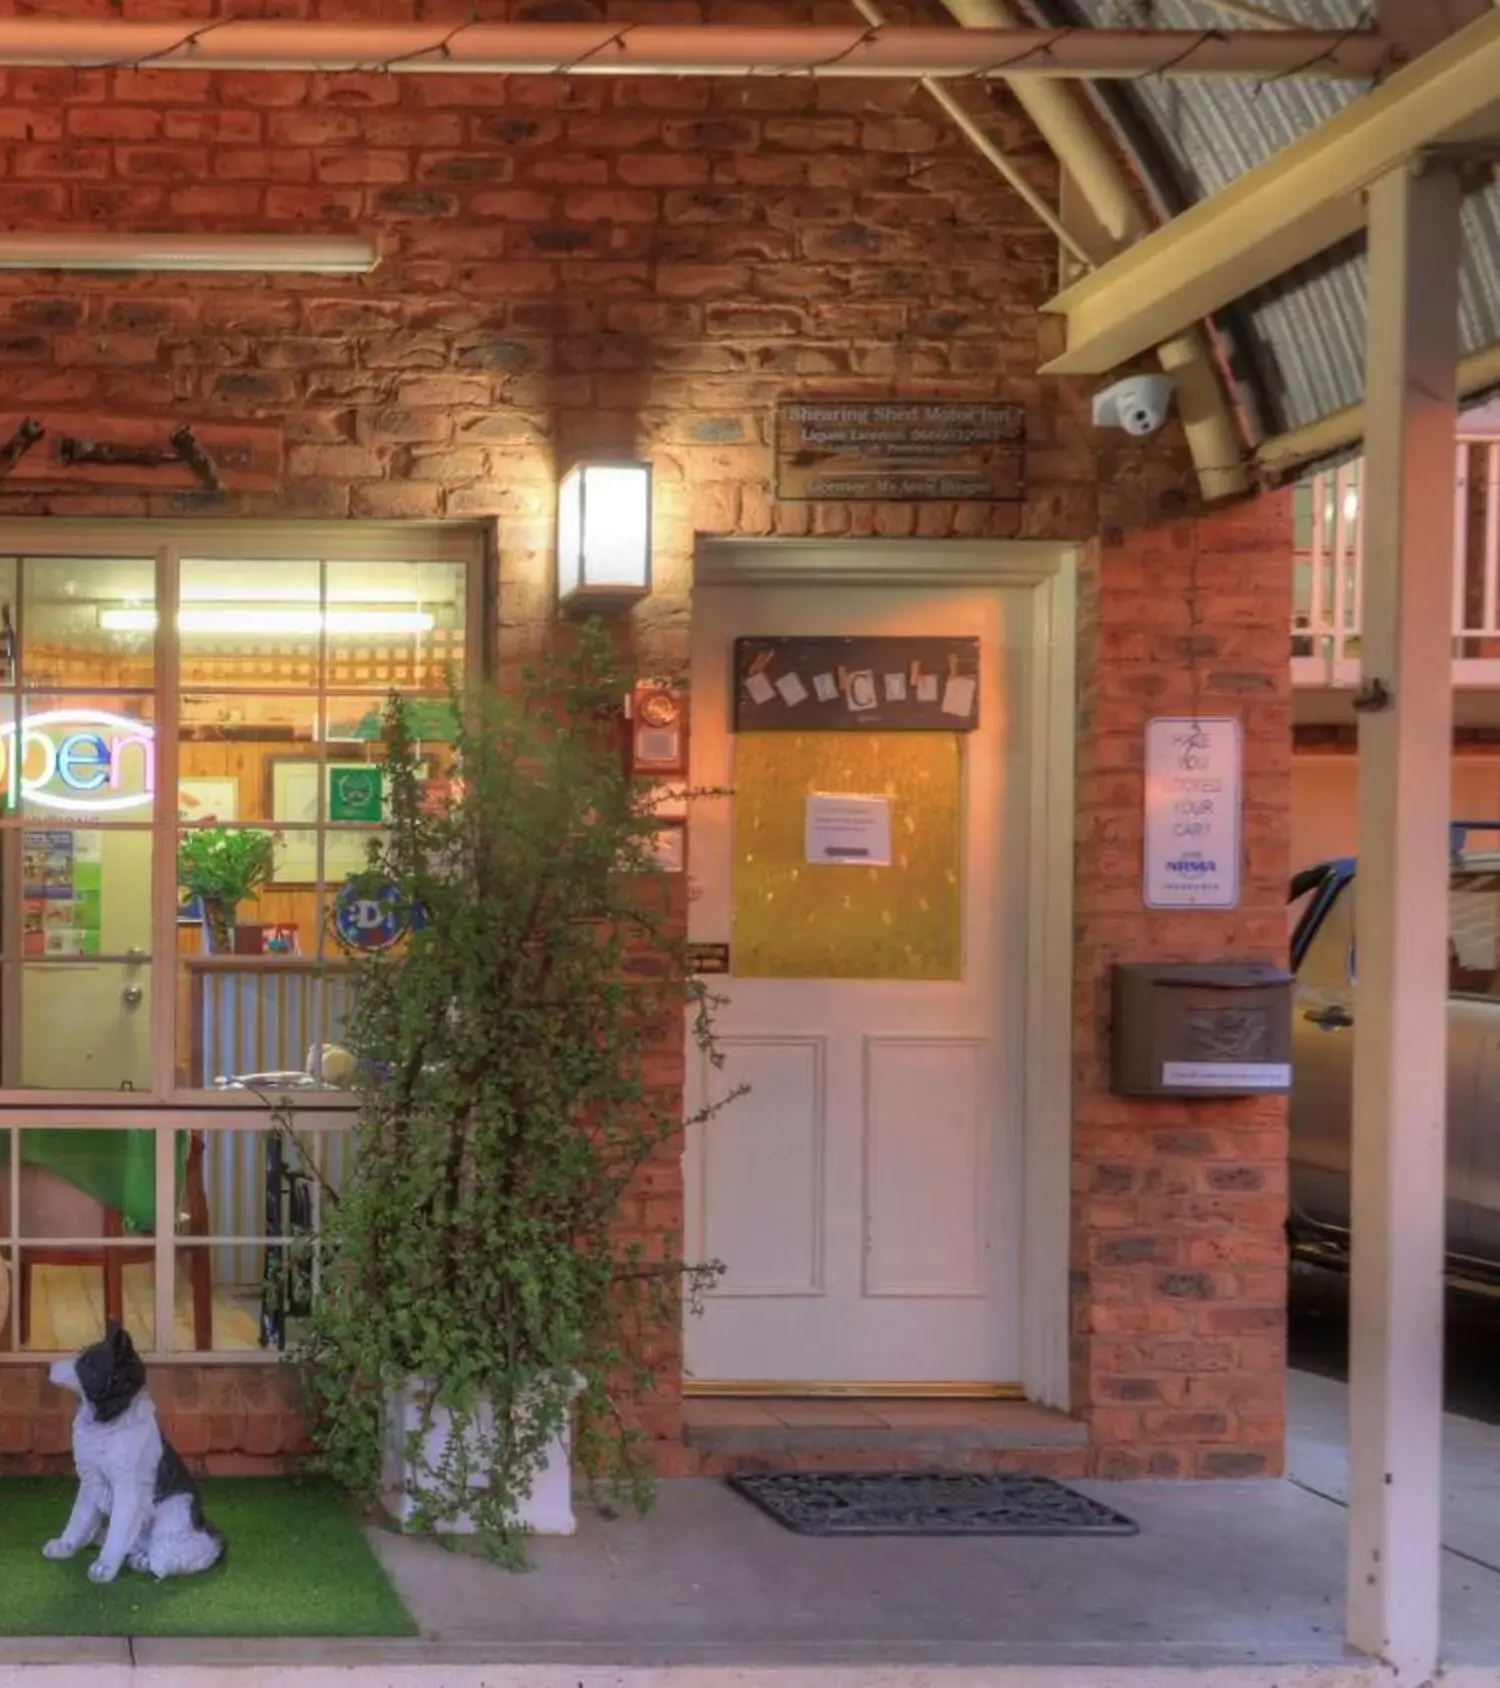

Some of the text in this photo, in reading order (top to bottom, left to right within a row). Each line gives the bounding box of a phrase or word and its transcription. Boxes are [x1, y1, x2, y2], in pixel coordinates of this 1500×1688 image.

[788, 405, 1012, 424] Shearing Shed Motor Inn
